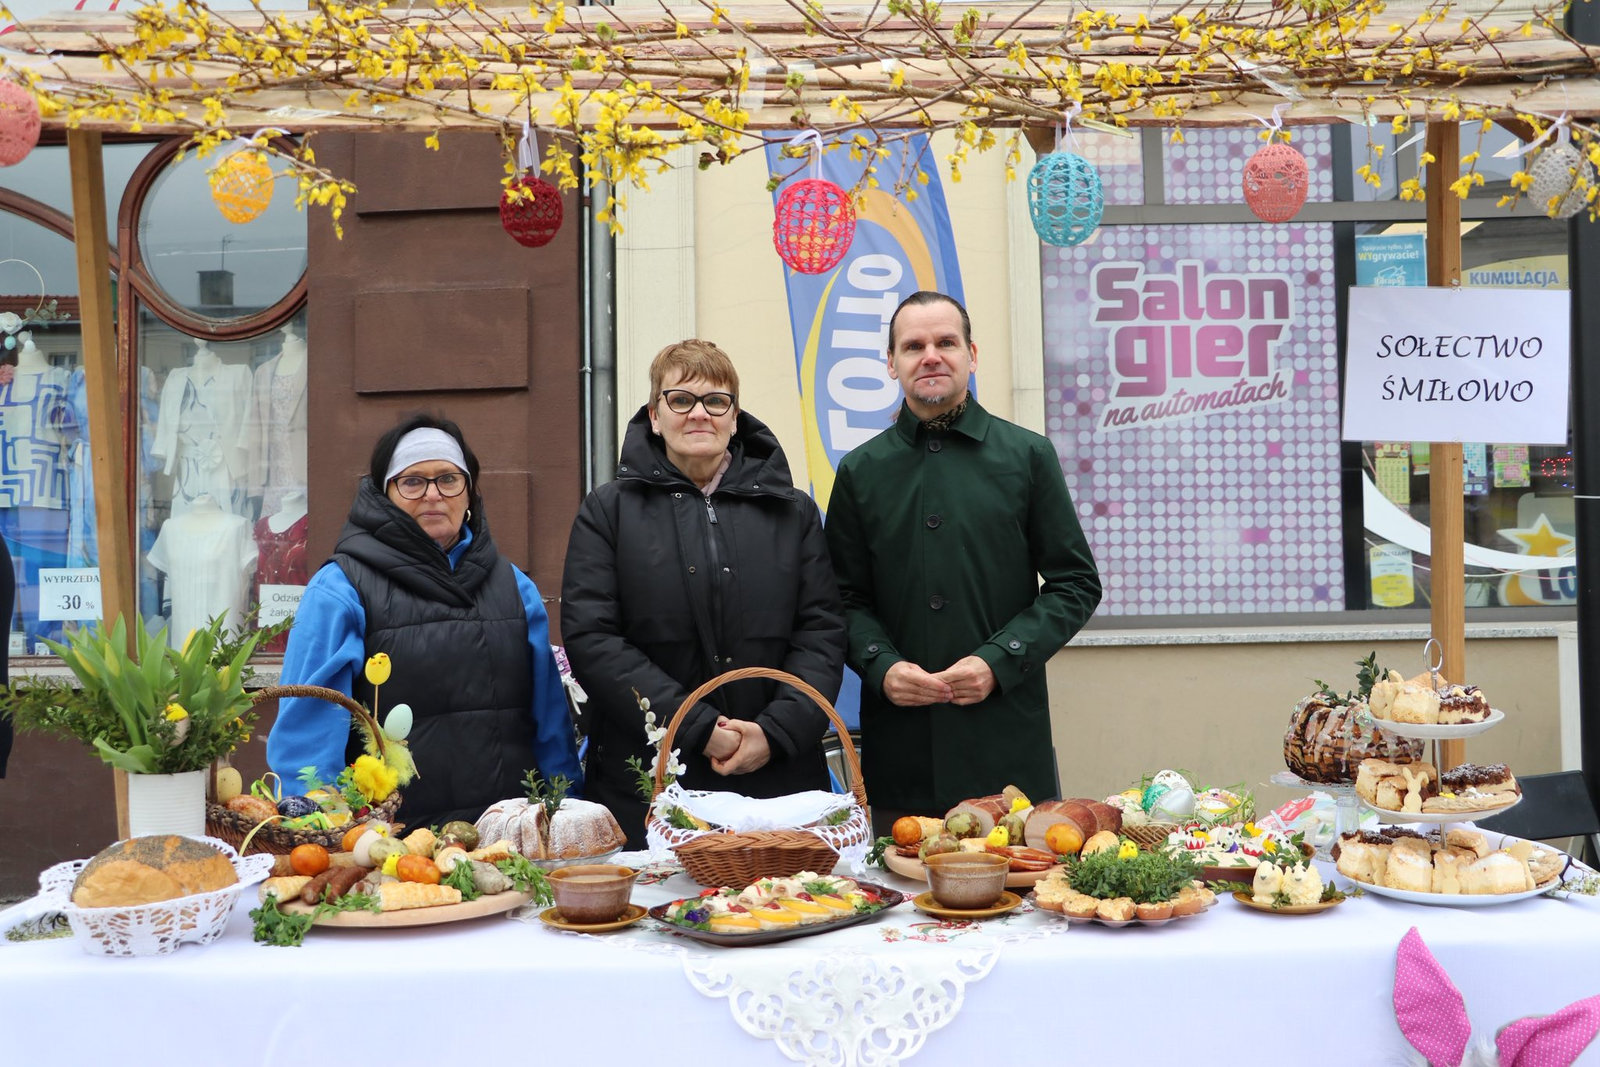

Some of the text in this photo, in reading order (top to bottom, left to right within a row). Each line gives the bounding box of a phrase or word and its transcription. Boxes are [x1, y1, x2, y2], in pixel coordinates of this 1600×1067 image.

[1358, 250, 1419, 262] WYgrywacie!
[1469, 271, 1559, 288] KUMULACJA
[1094, 264, 1290, 322] Salon
[1376, 334, 1543, 359] SOŁECTWO
[1114, 323, 1284, 398] gier
[1103, 371, 1288, 428] na automatach
[1381, 374, 1535, 402] ŚMIŁOWO
[43, 575, 100, 584] WYPRZEDA
[1537, 566, 1577, 600] LO
[57, 594, 95, 610] -30 %
[269, 608, 295, 617] żałob
